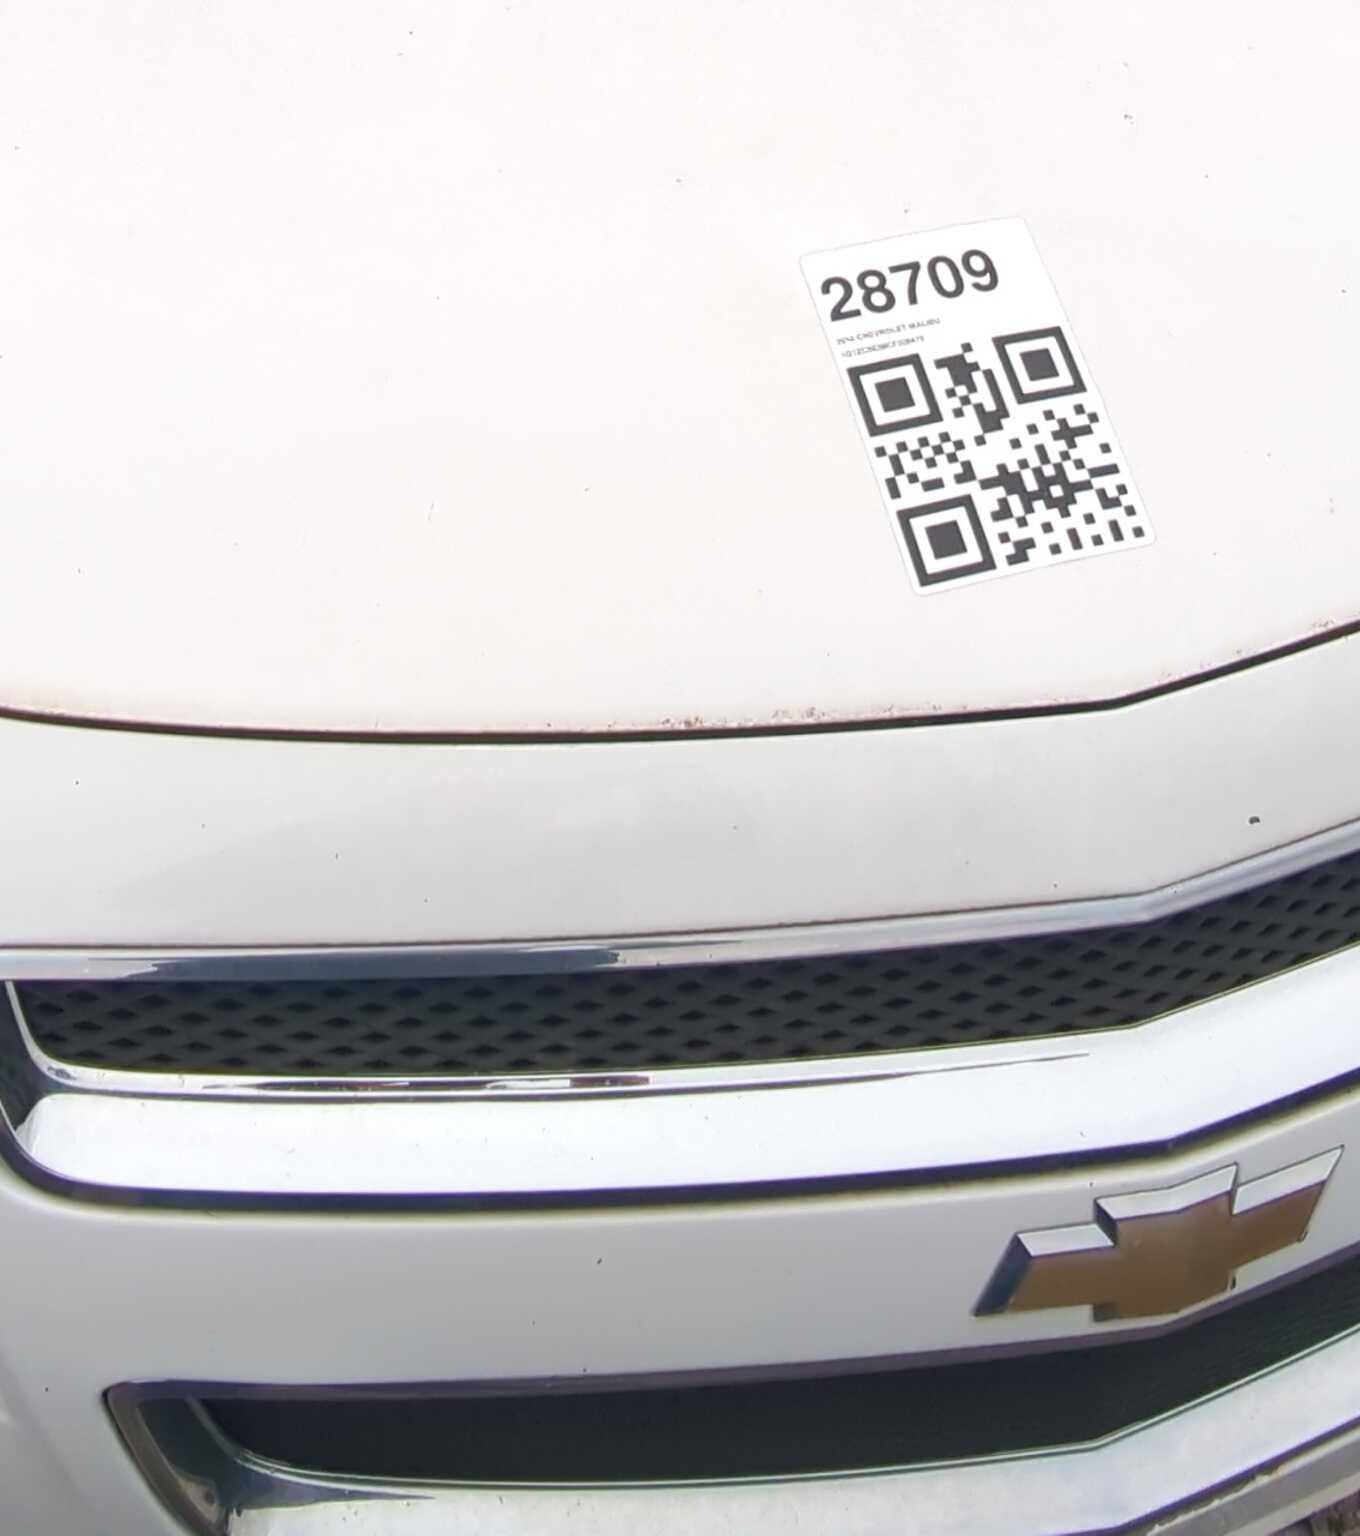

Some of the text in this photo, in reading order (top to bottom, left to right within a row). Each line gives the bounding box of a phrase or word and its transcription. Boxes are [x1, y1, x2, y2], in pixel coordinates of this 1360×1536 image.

[820, 249, 999, 322] 28709
[856, 324, 907, 341] CHEVROLET
[908, 317, 941, 330] MALIBU
